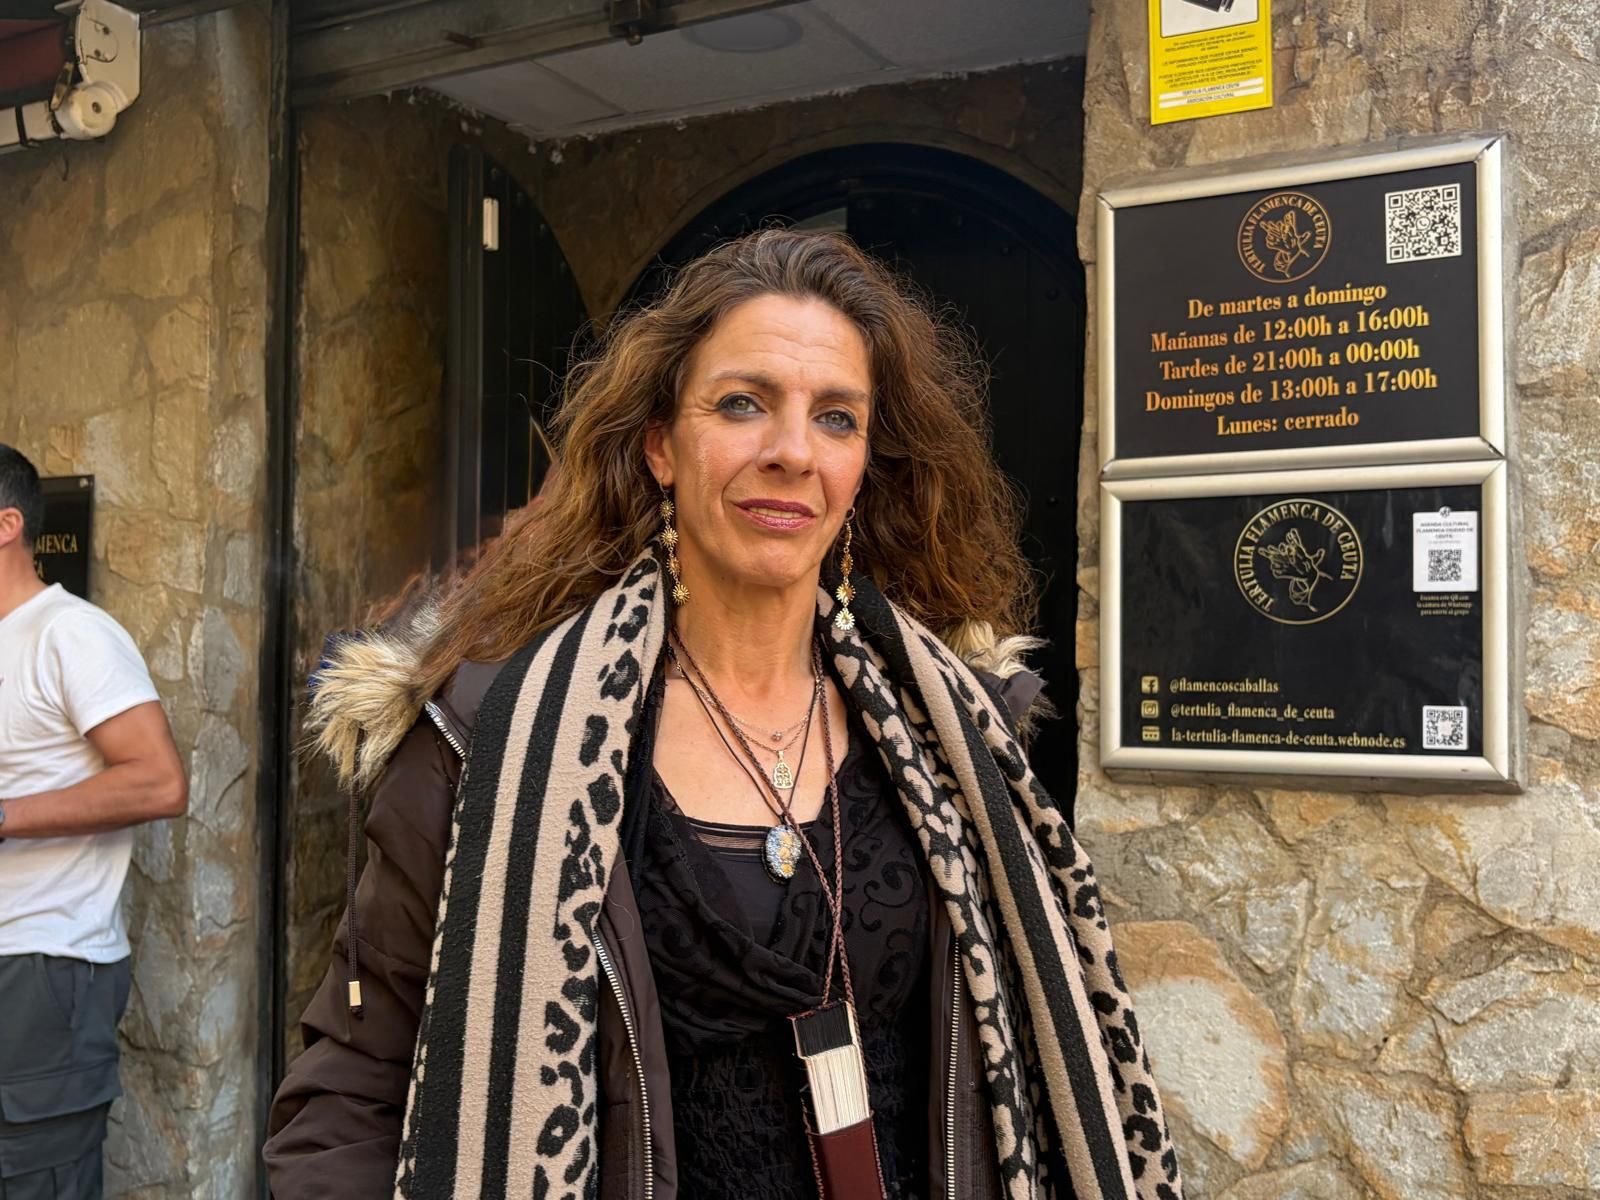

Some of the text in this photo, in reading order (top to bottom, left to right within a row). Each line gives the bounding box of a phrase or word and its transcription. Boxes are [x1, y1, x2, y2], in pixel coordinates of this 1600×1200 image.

[1248, 196, 1302, 225] FLAMENCA
[1302, 202, 1318, 216] DE
[1312, 214, 1327, 249] CEUTA
[1188, 283, 1387, 319] De martes a domingo
[1151, 305, 1430, 352] Mañanas de 12:00h a 16:00h
[1159, 338, 1420, 380] Tardes de 21:00h a 00:00h
[1145, 368, 1438, 411] Domingos de 13:00h a 17:00h
[1216, 406, 1360, 436] Lunes: cerrado
[1239, 504, 1358, 612] TERTULIA FLAMENCA DE CEUTA
[1169, 678, 1280, 693] @flamencoscaballas
[1170, 702, 1335, 722] @tertulia_flamenca_de_ceuta
[1171, 727, 1406, 749] la-tertulia-flamenca-de-ceuta.webnode.es
